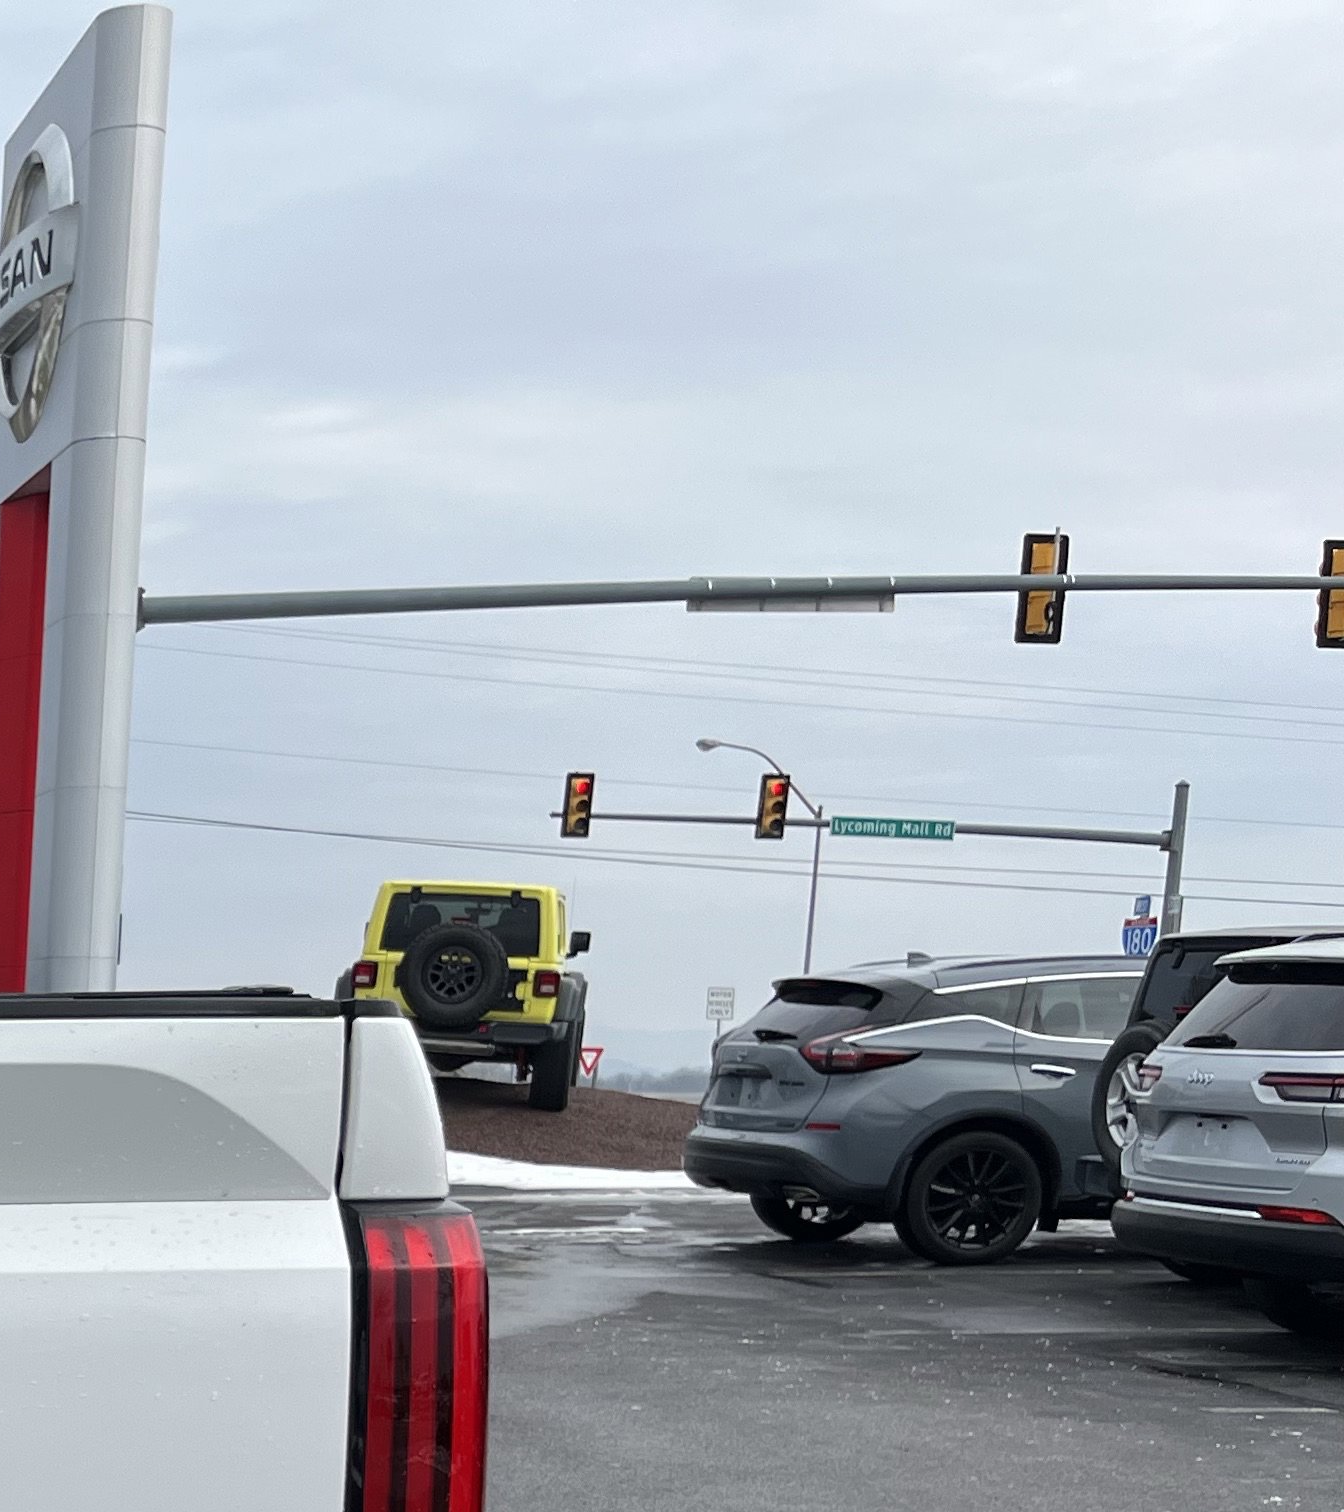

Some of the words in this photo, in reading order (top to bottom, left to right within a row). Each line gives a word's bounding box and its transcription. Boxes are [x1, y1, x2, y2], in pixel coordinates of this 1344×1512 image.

[834, 819, 897, 838] Lycoming
[901, 823, 929, 837] Mall
[934, 823, 952, 837] Rd
[1126, 928, 1152, 954] 180
